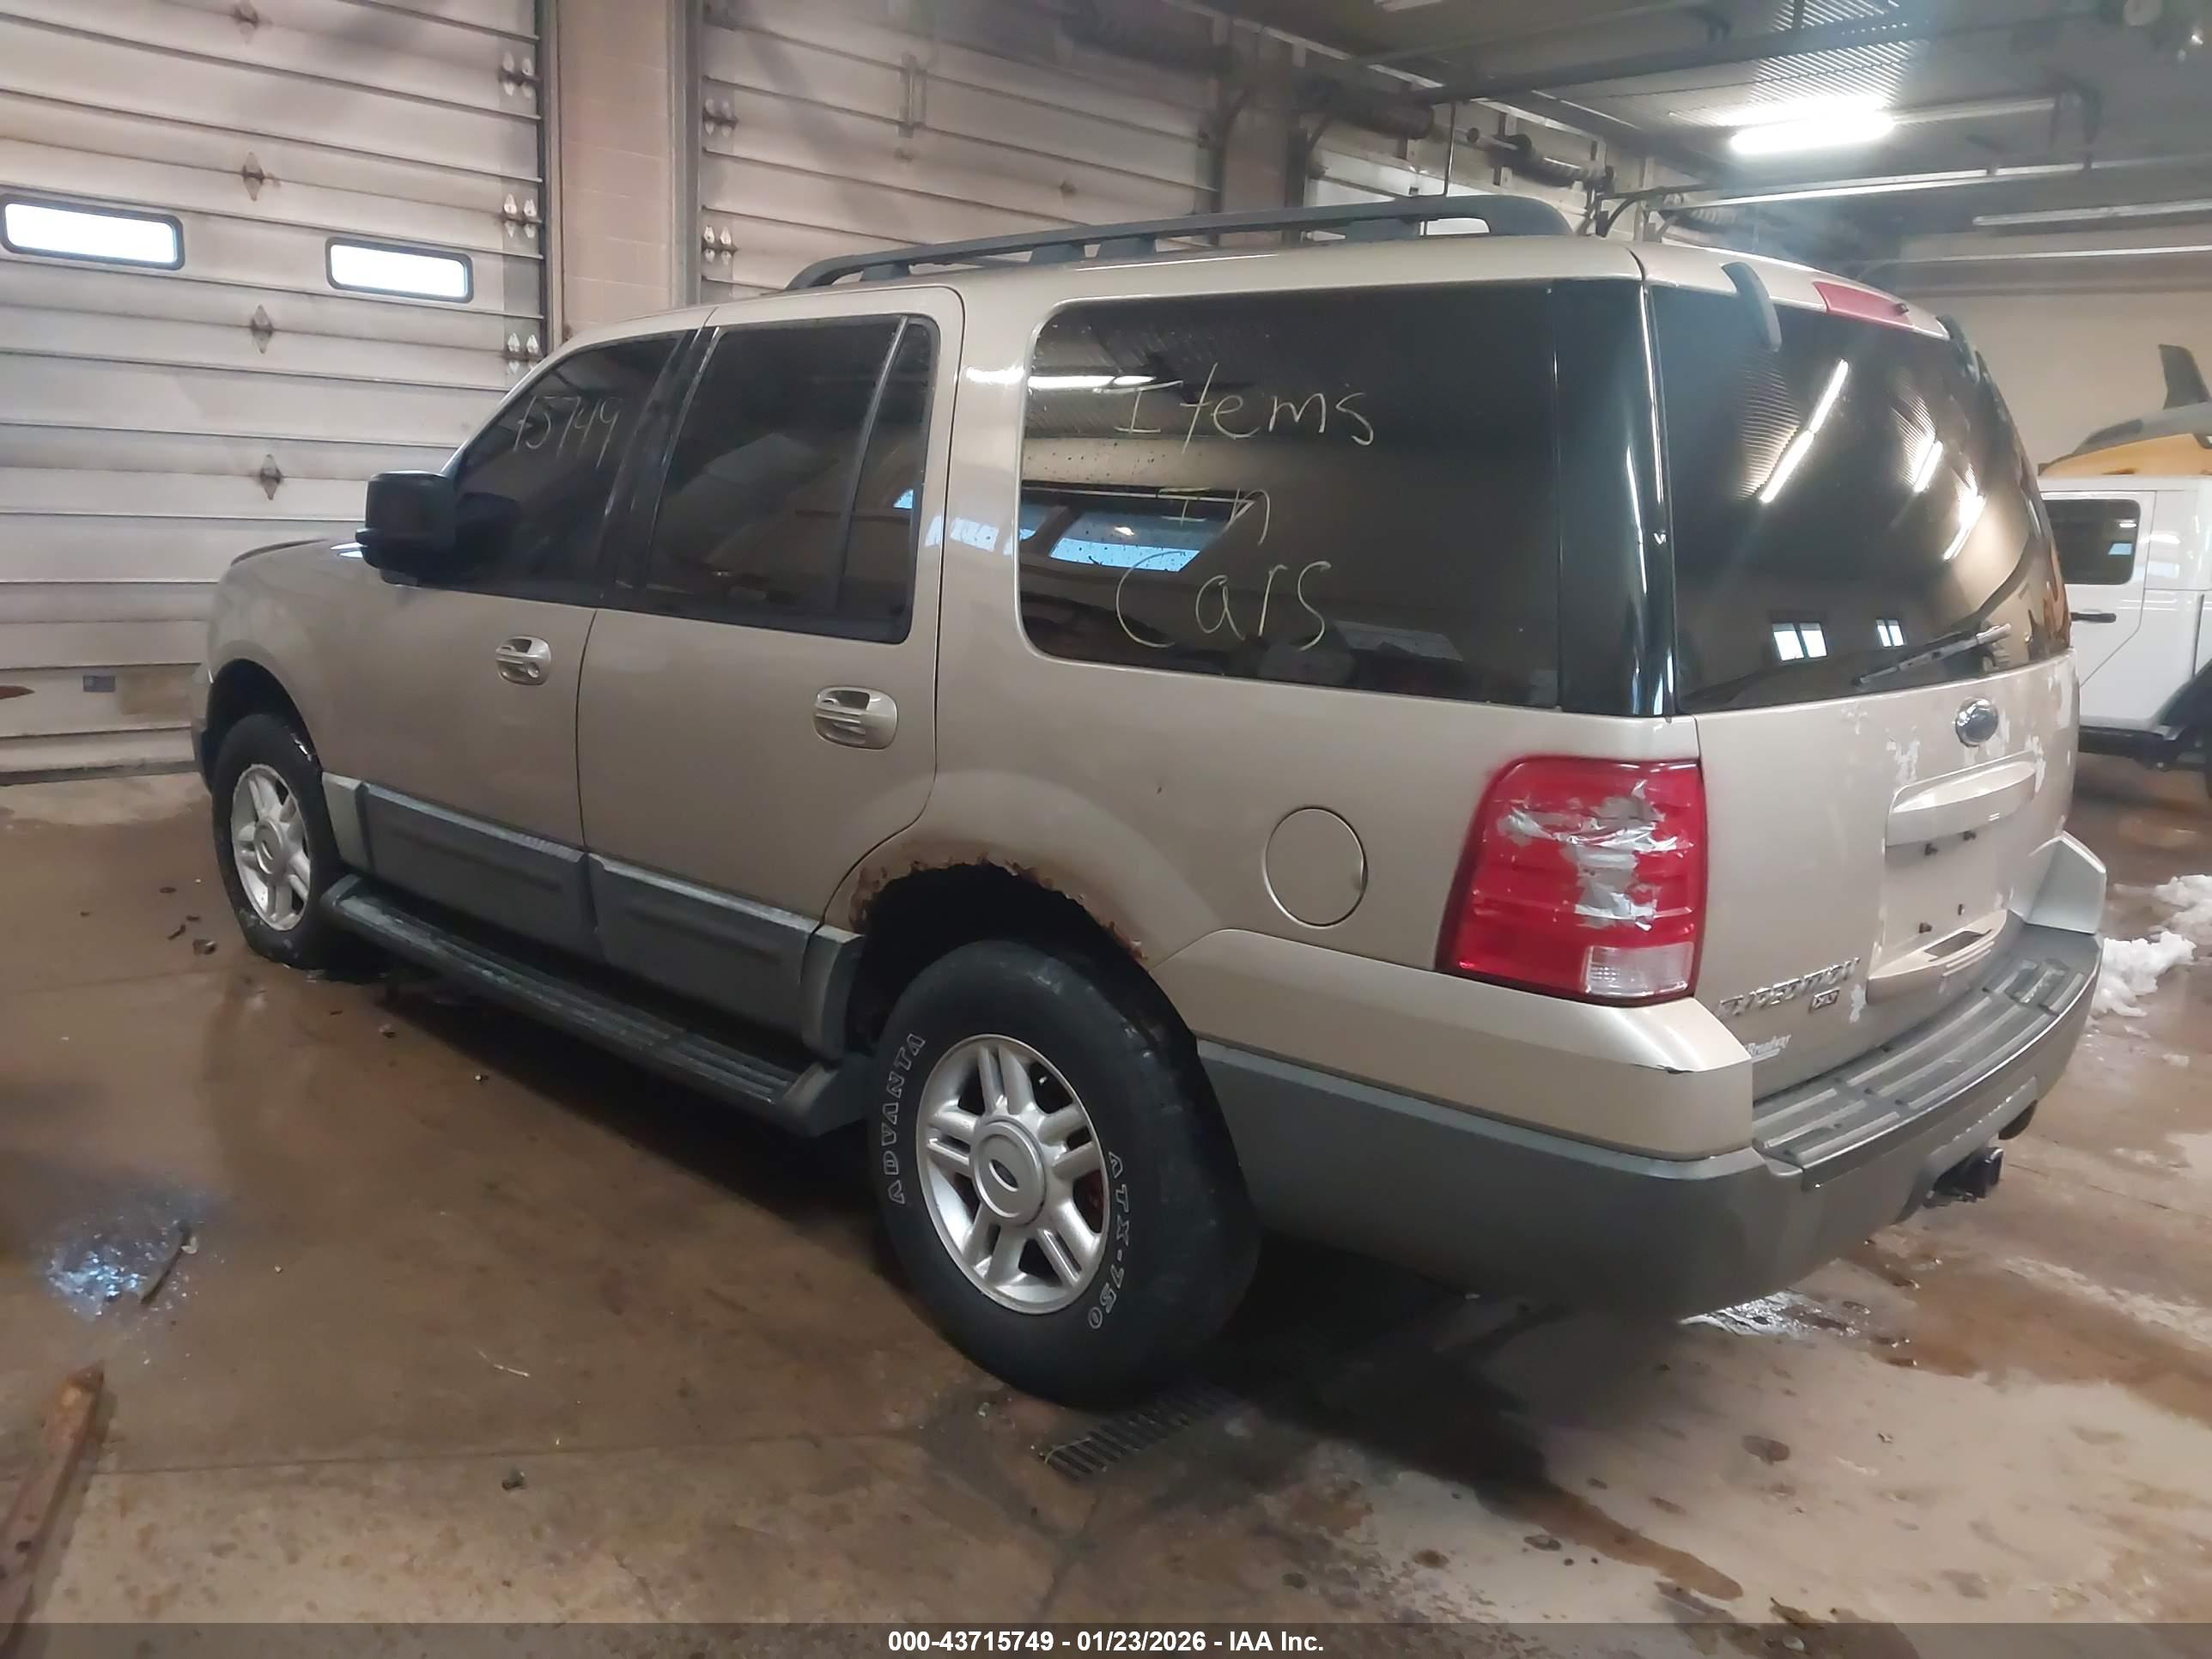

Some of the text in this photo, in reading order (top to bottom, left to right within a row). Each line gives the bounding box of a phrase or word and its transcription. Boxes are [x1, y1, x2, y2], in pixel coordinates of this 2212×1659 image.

[1095, 362, 1374, 454] Items
[1156, 487, 1272, 545] In
[1115, 560, 1333, 652] Cars
[880, 1033, 927, 1205] ADVANTA
